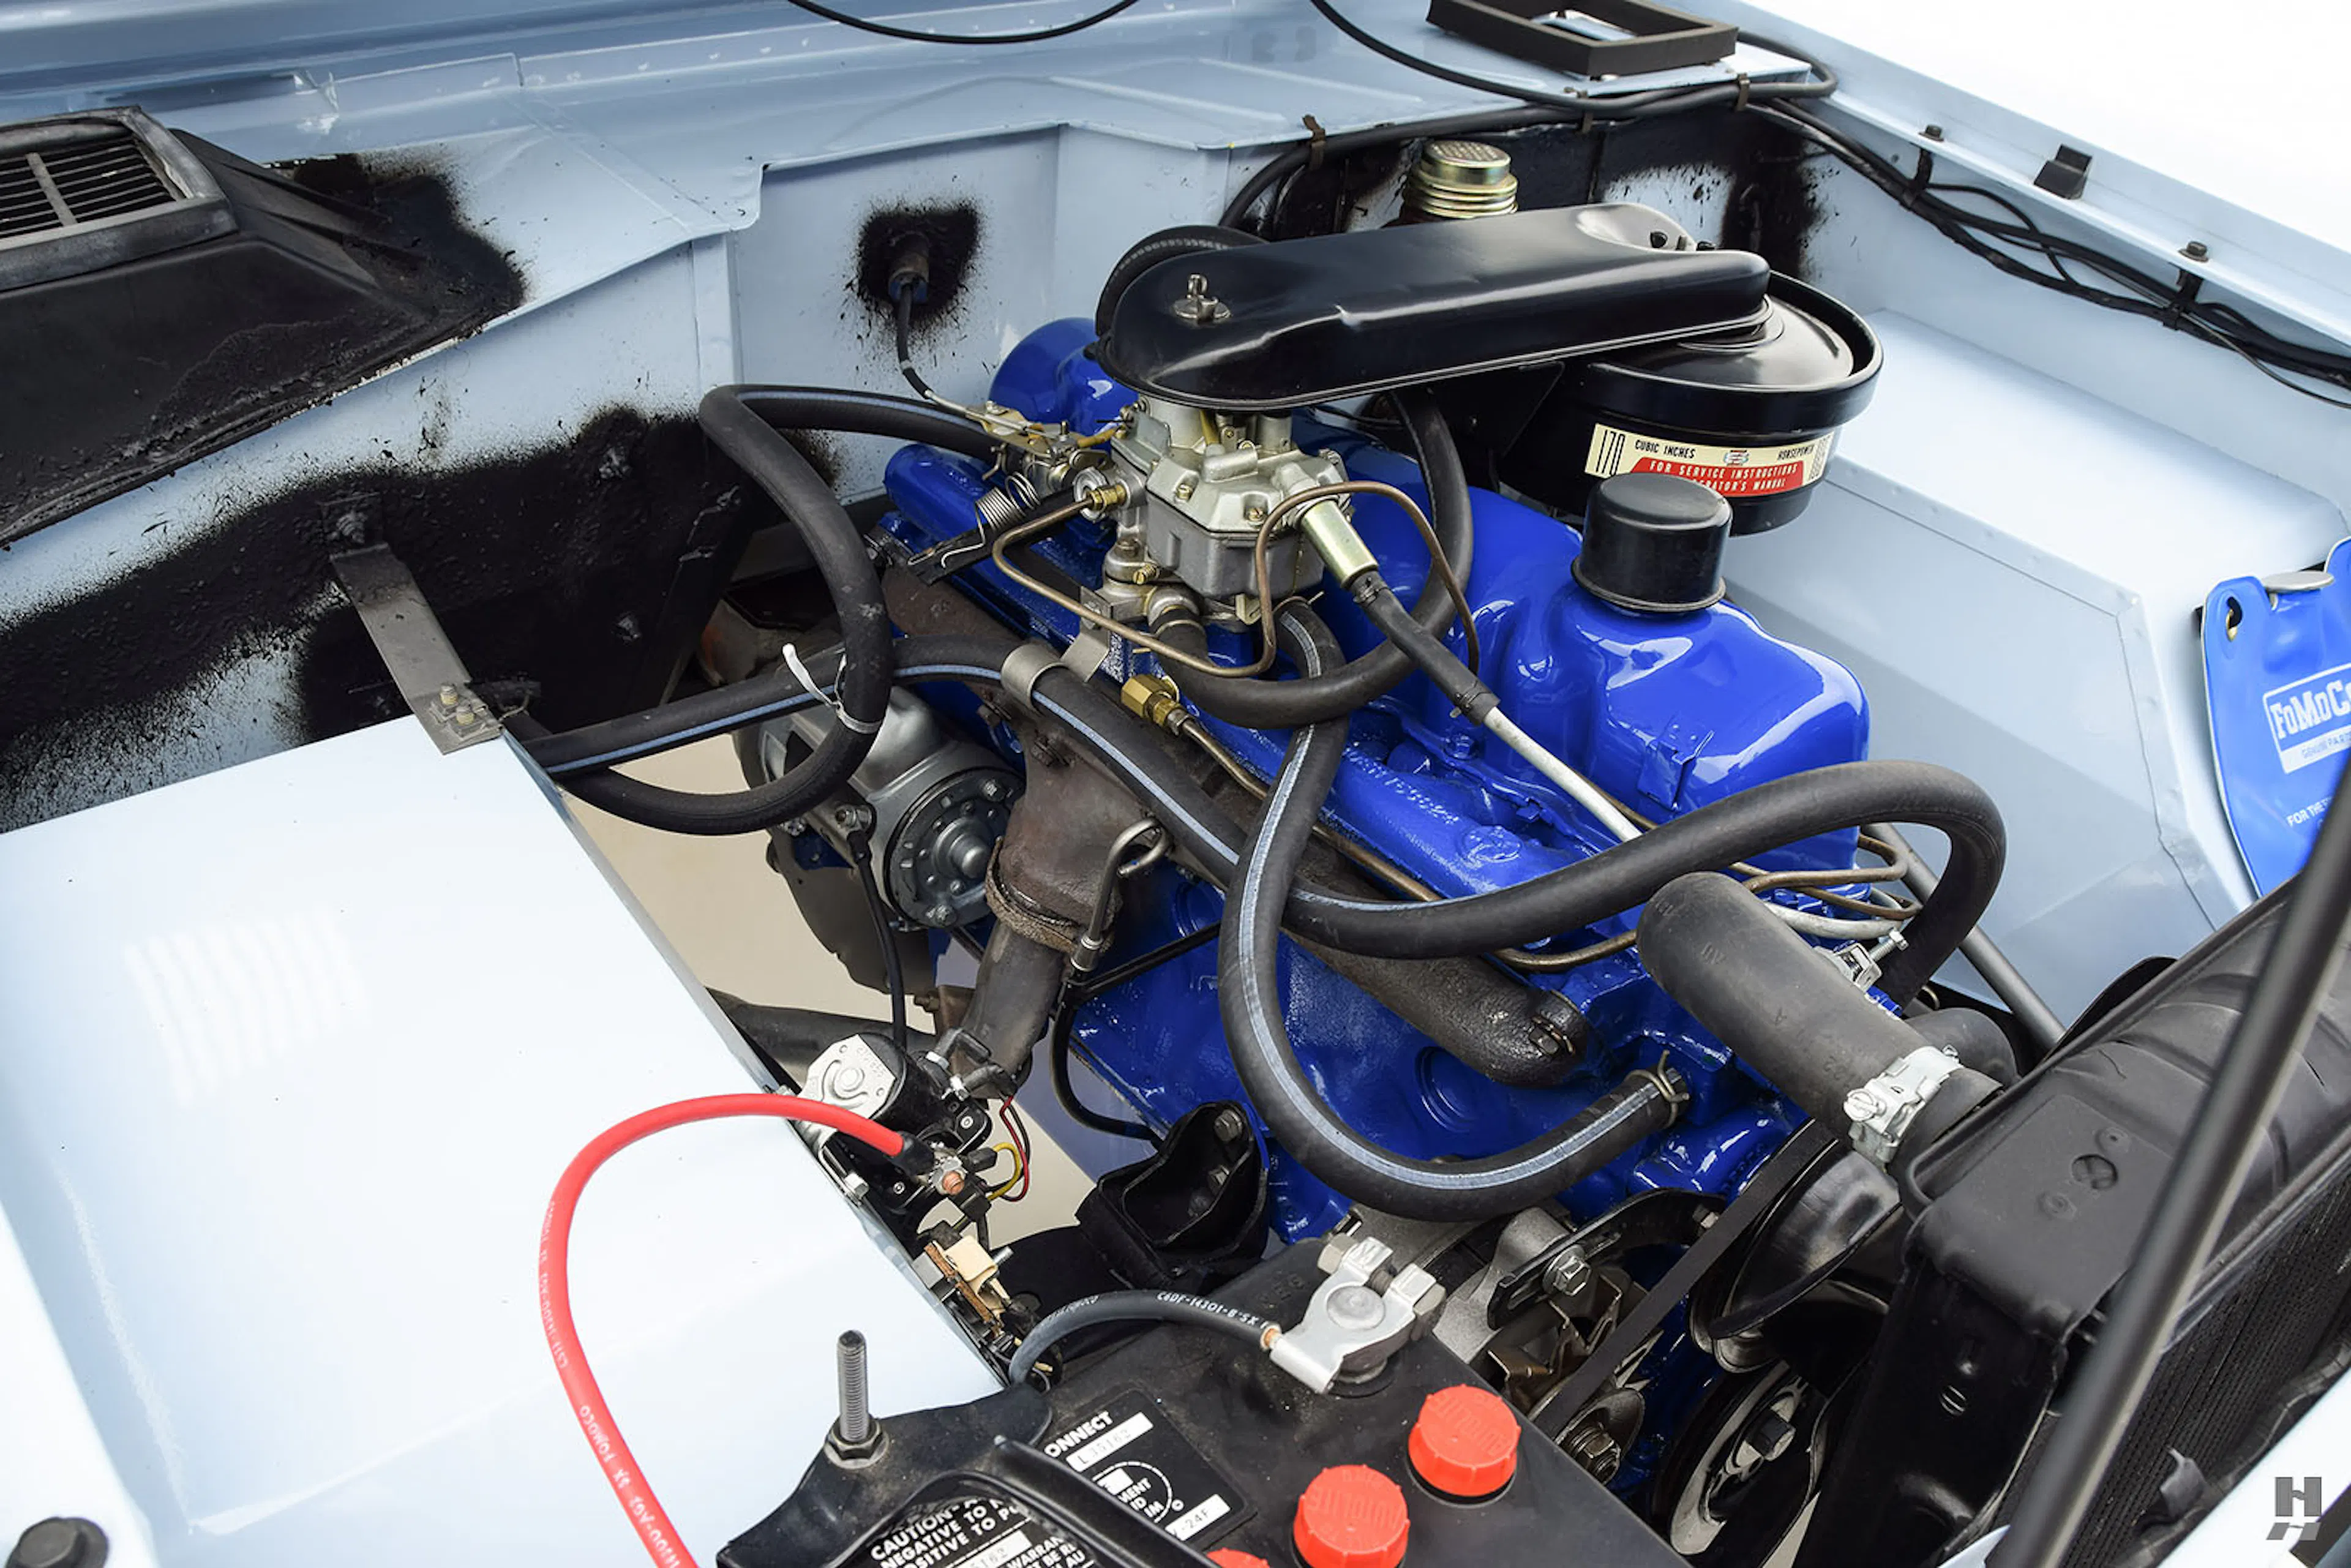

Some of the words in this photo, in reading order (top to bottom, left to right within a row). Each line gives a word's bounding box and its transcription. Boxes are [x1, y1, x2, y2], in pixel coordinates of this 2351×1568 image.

[1595, 429, 1625, 476] 170
[1635, 440, 1659, 453] CUBIC
[1663, 446, 1696, 459] INCHES
[1649, 460, 1673, 473] FOR
[1679, 464, 1726, 479] SERVICE
[1730, 463, 1798, 480] INSTRUCTIONS
[2286, 809, 2309, 828] FOR
[1044, 1410, 1113, 1458] ONNECT
[880, 1520, 962, 1568] NEGATIVE
[963, 1506, 987, 1524] TO
[970, 1517, 996, 1536] TO
